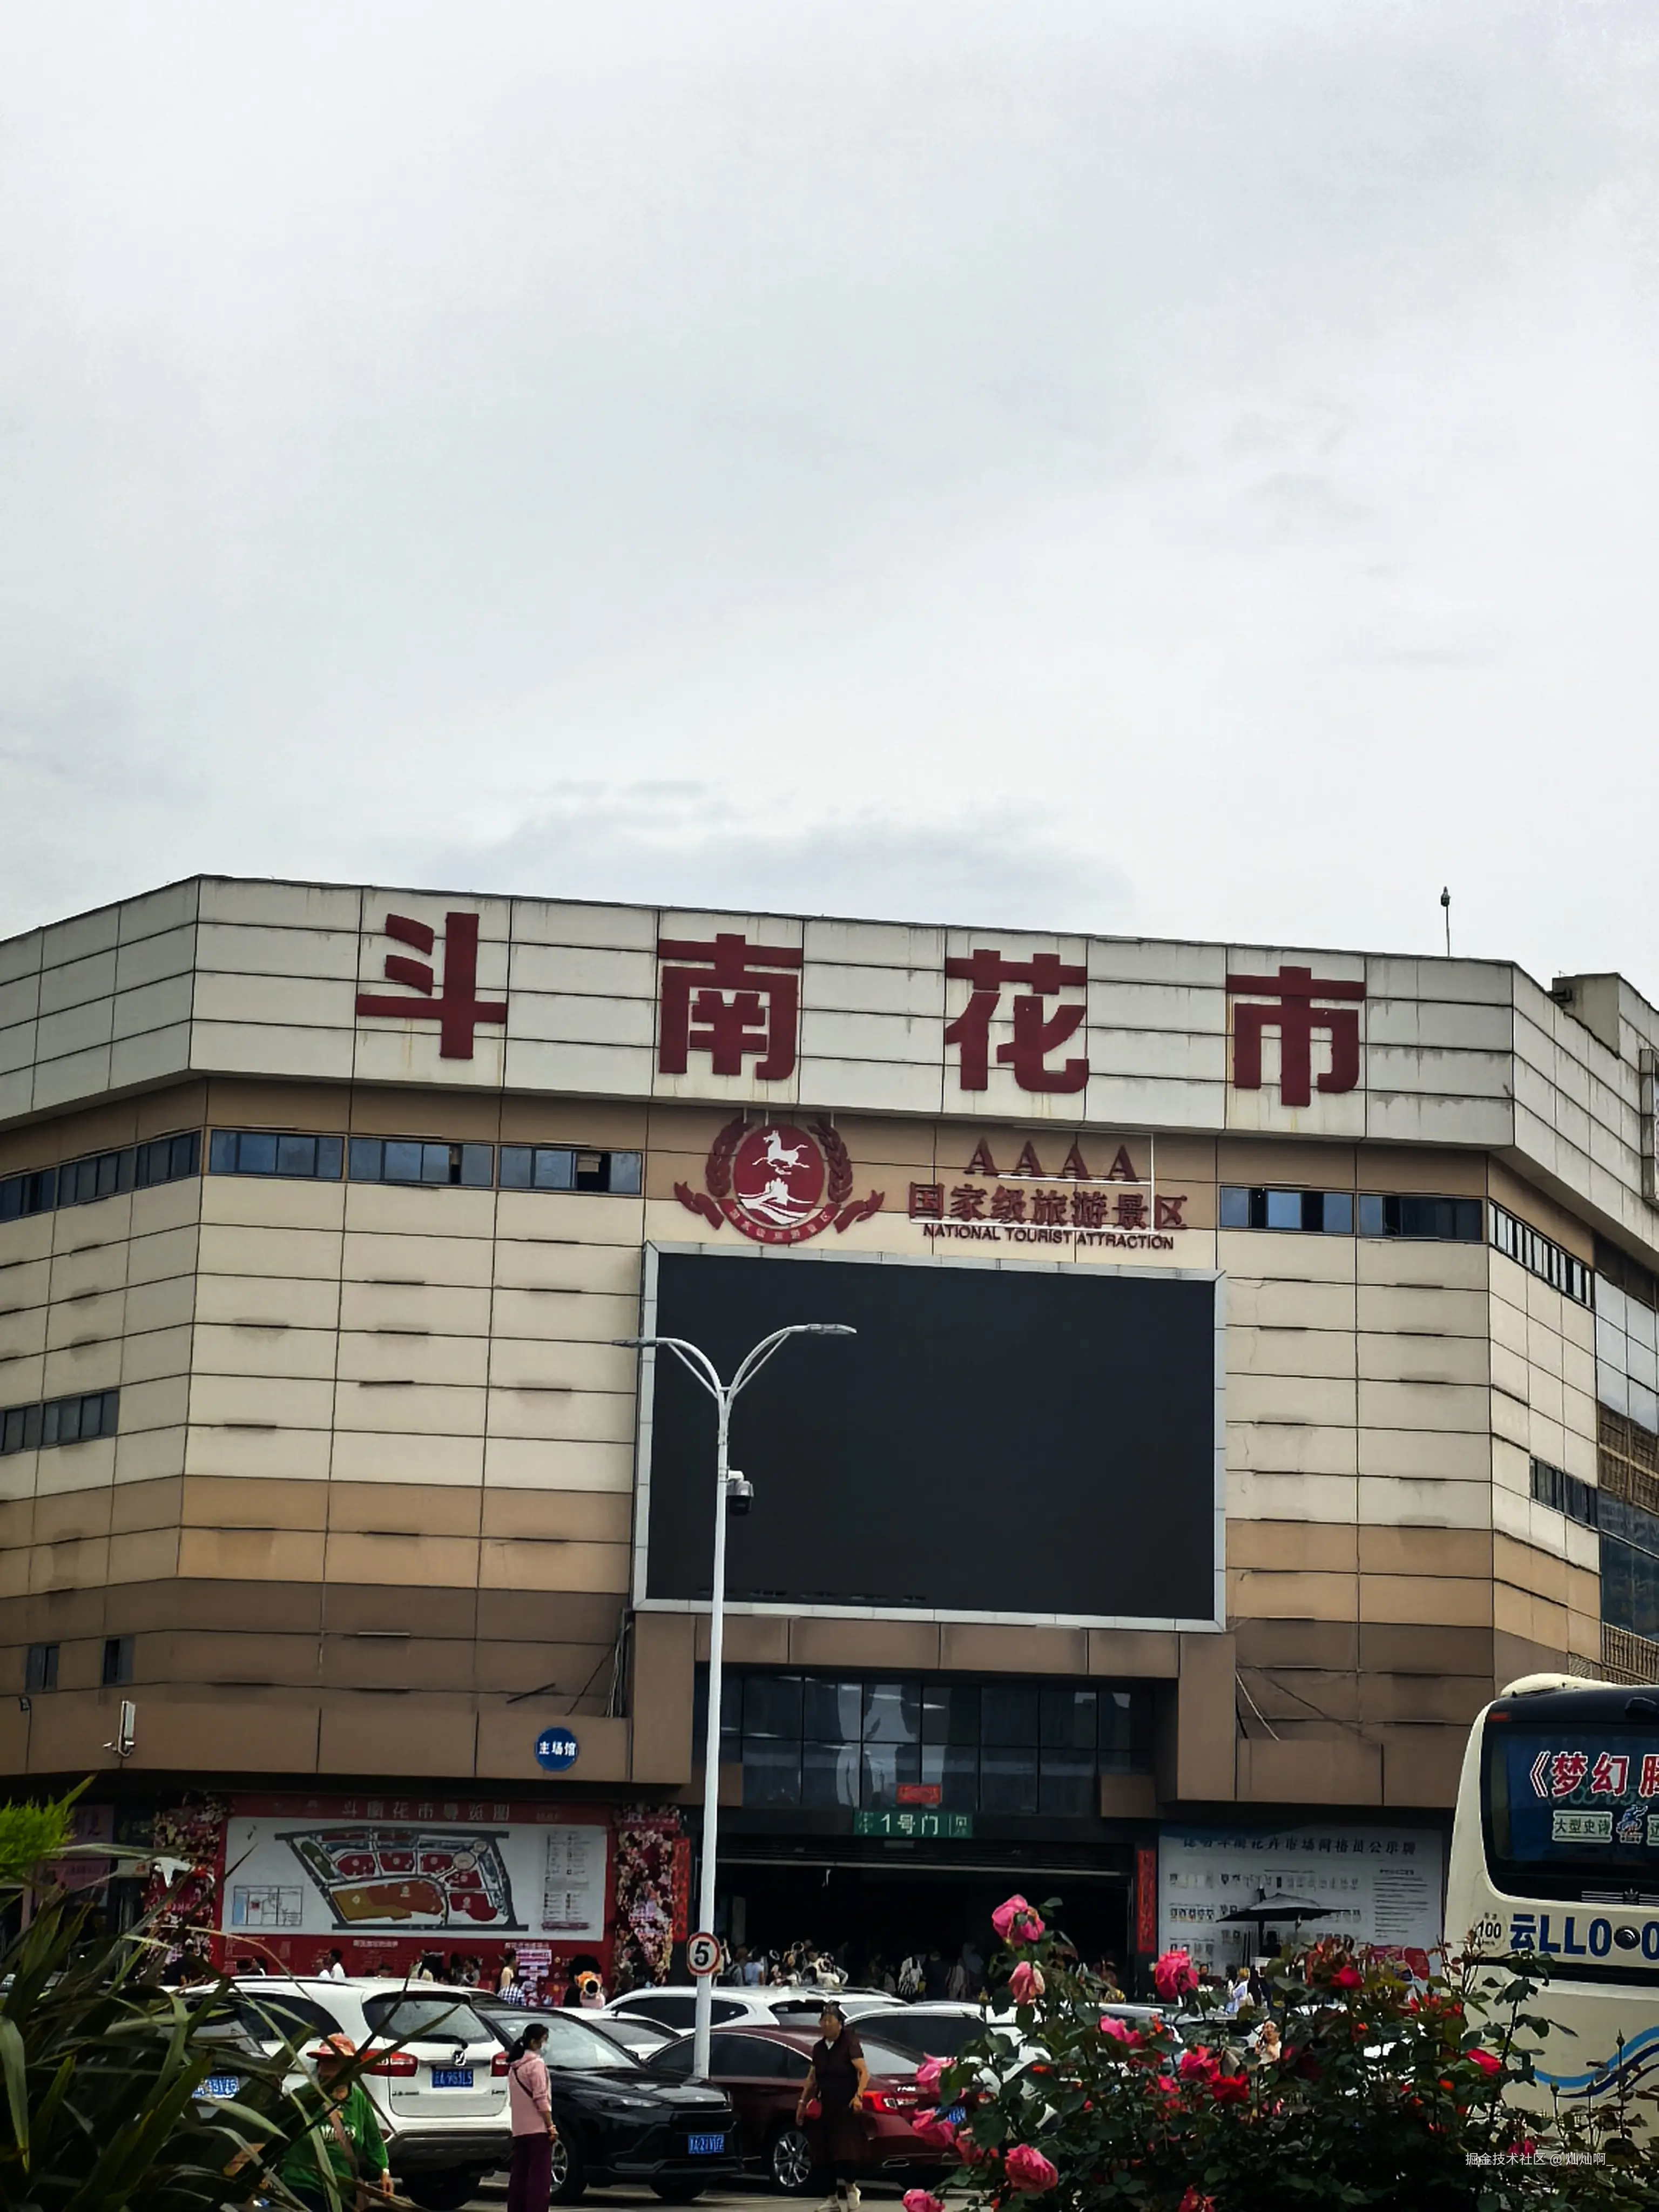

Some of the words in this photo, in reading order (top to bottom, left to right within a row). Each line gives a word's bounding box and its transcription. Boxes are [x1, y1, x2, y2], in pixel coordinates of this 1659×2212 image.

[356, 912, 1366, 1107] 斗南花市
[963, 1138, 1138, 1182] AAAA
[909, 1182, 1188, 1230] 国家级旅游景区
[922, 1224, 1001, 1241] NATIONAL
[1006, 1227, 1073, 1244] TOURIST
[1076, 1231, 1174, 1250] ATTRACTION
[539, 1741, 576, 1756] 主场馆
[880, 1813, 939, 1835] 1号门
[1555, 1818, 1610, 1835] 大型史诗
[1476, 1920, 1501, 1939] 100
[694, 1941, 710, 1966] 5
